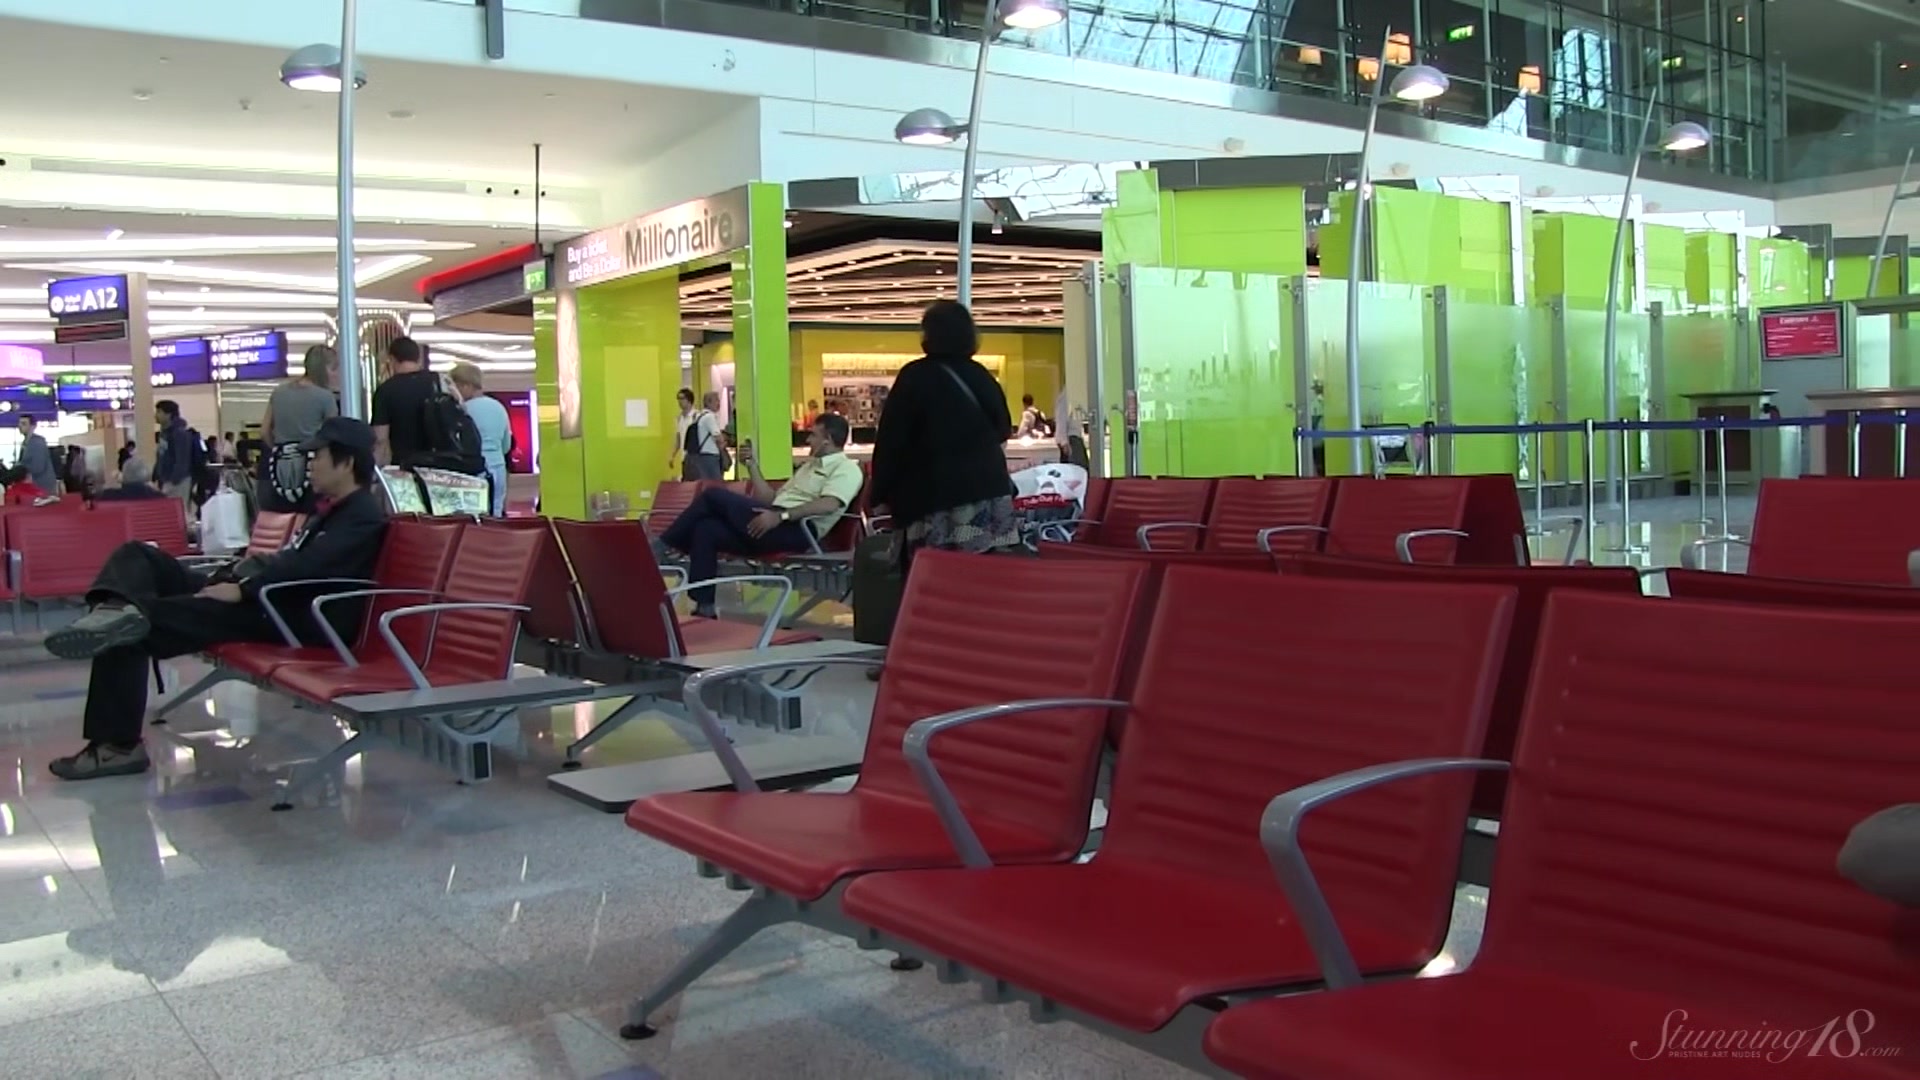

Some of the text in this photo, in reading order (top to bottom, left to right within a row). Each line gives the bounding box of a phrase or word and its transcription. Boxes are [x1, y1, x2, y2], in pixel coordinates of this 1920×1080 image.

[625, 208, 733, 269] Millionaire
[567, 247, 581, 264] Buy
[582, 246, 588, 258] a
[568, 264, 582, 282] and
[583, 262, 593, 278] Be
[82, 287, 118, 310] A12
